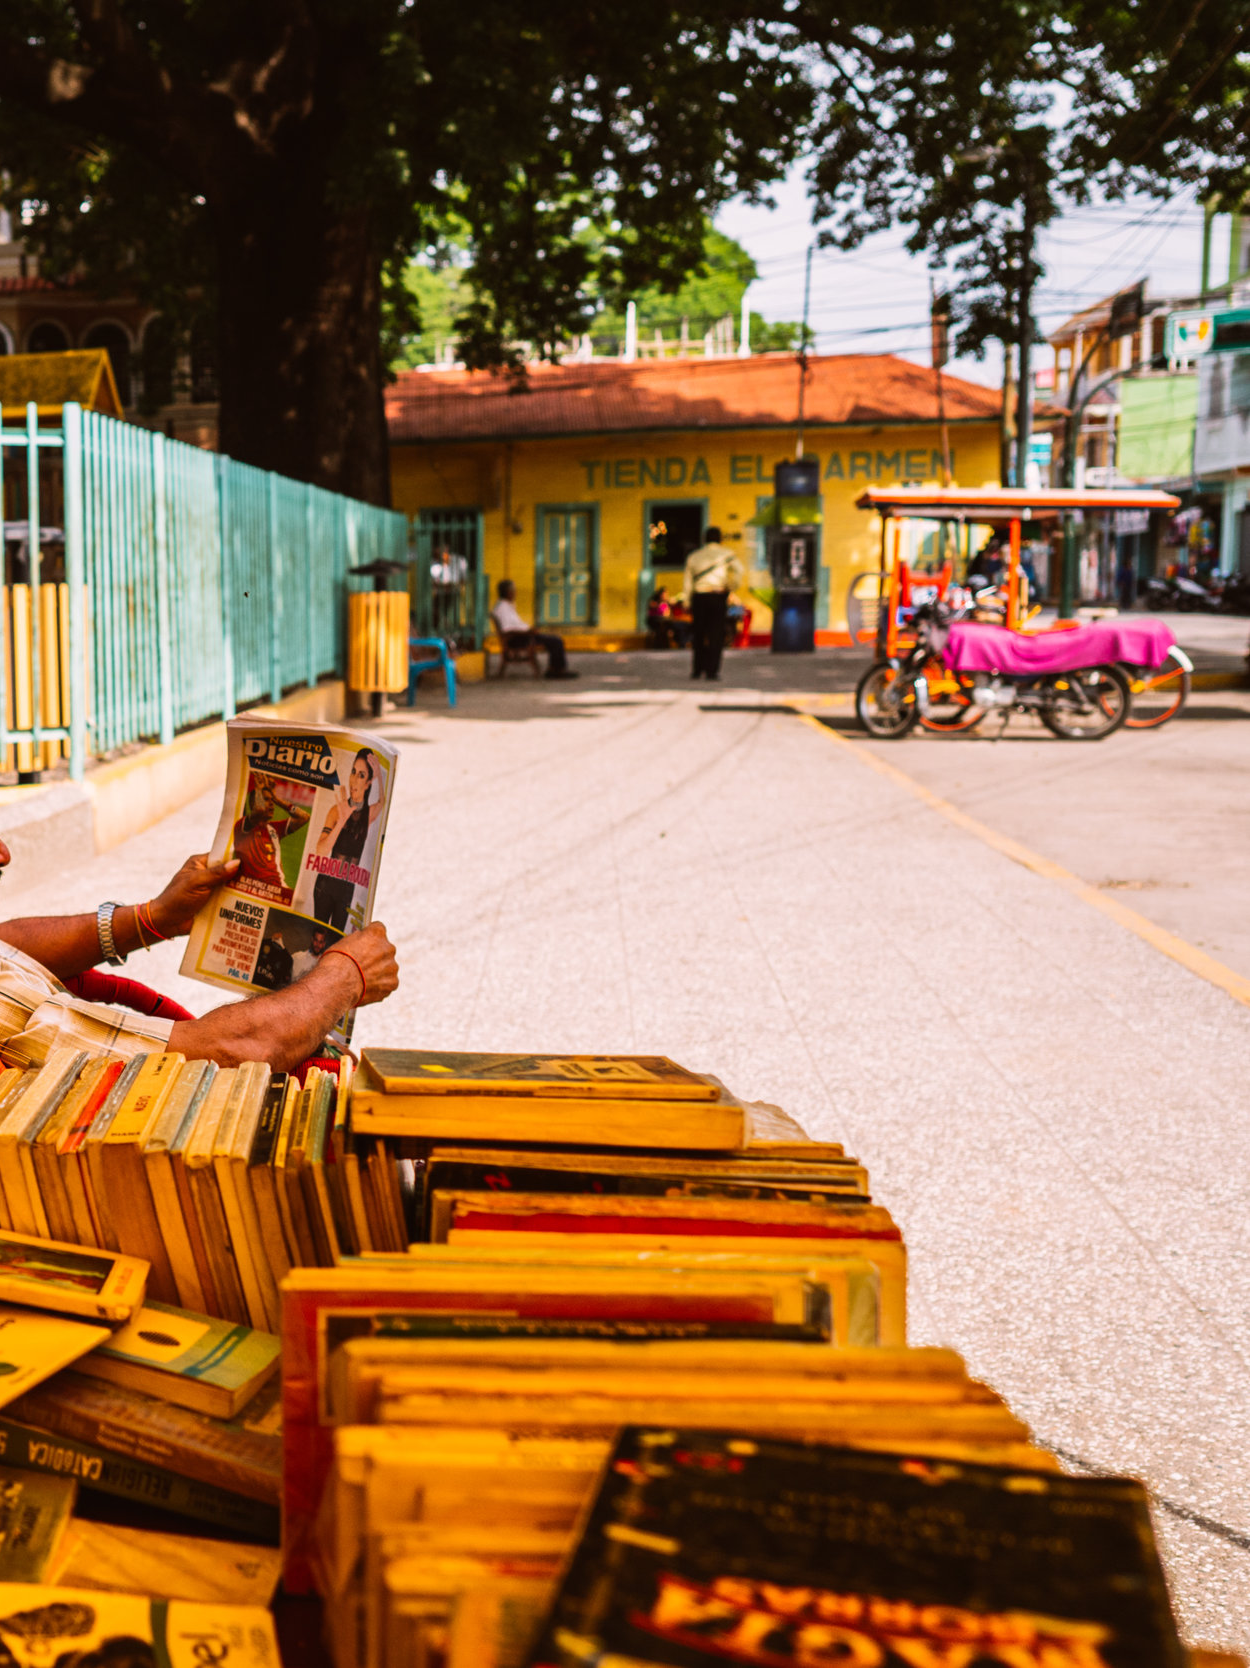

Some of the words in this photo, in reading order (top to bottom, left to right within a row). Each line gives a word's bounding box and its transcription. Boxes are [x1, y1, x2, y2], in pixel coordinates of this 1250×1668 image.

[579, 455, 712, 489] TIENDA
[730, 455, 776, 484] EL
[820, 449, 958, 480] ARMEN
[270, 736, 323, 752] Nuestro
[245, 739, 337, 775] Diario
[254, 759, 287, 771] Noticias
[288, 767, 309, 777] como
[310, 772, 324, 781] son
[306, 854, 350, 880] FABIOLA
[219, 907, 263, 930] UNIFORMES
[234, 900, 265, 918] NUEVOS
